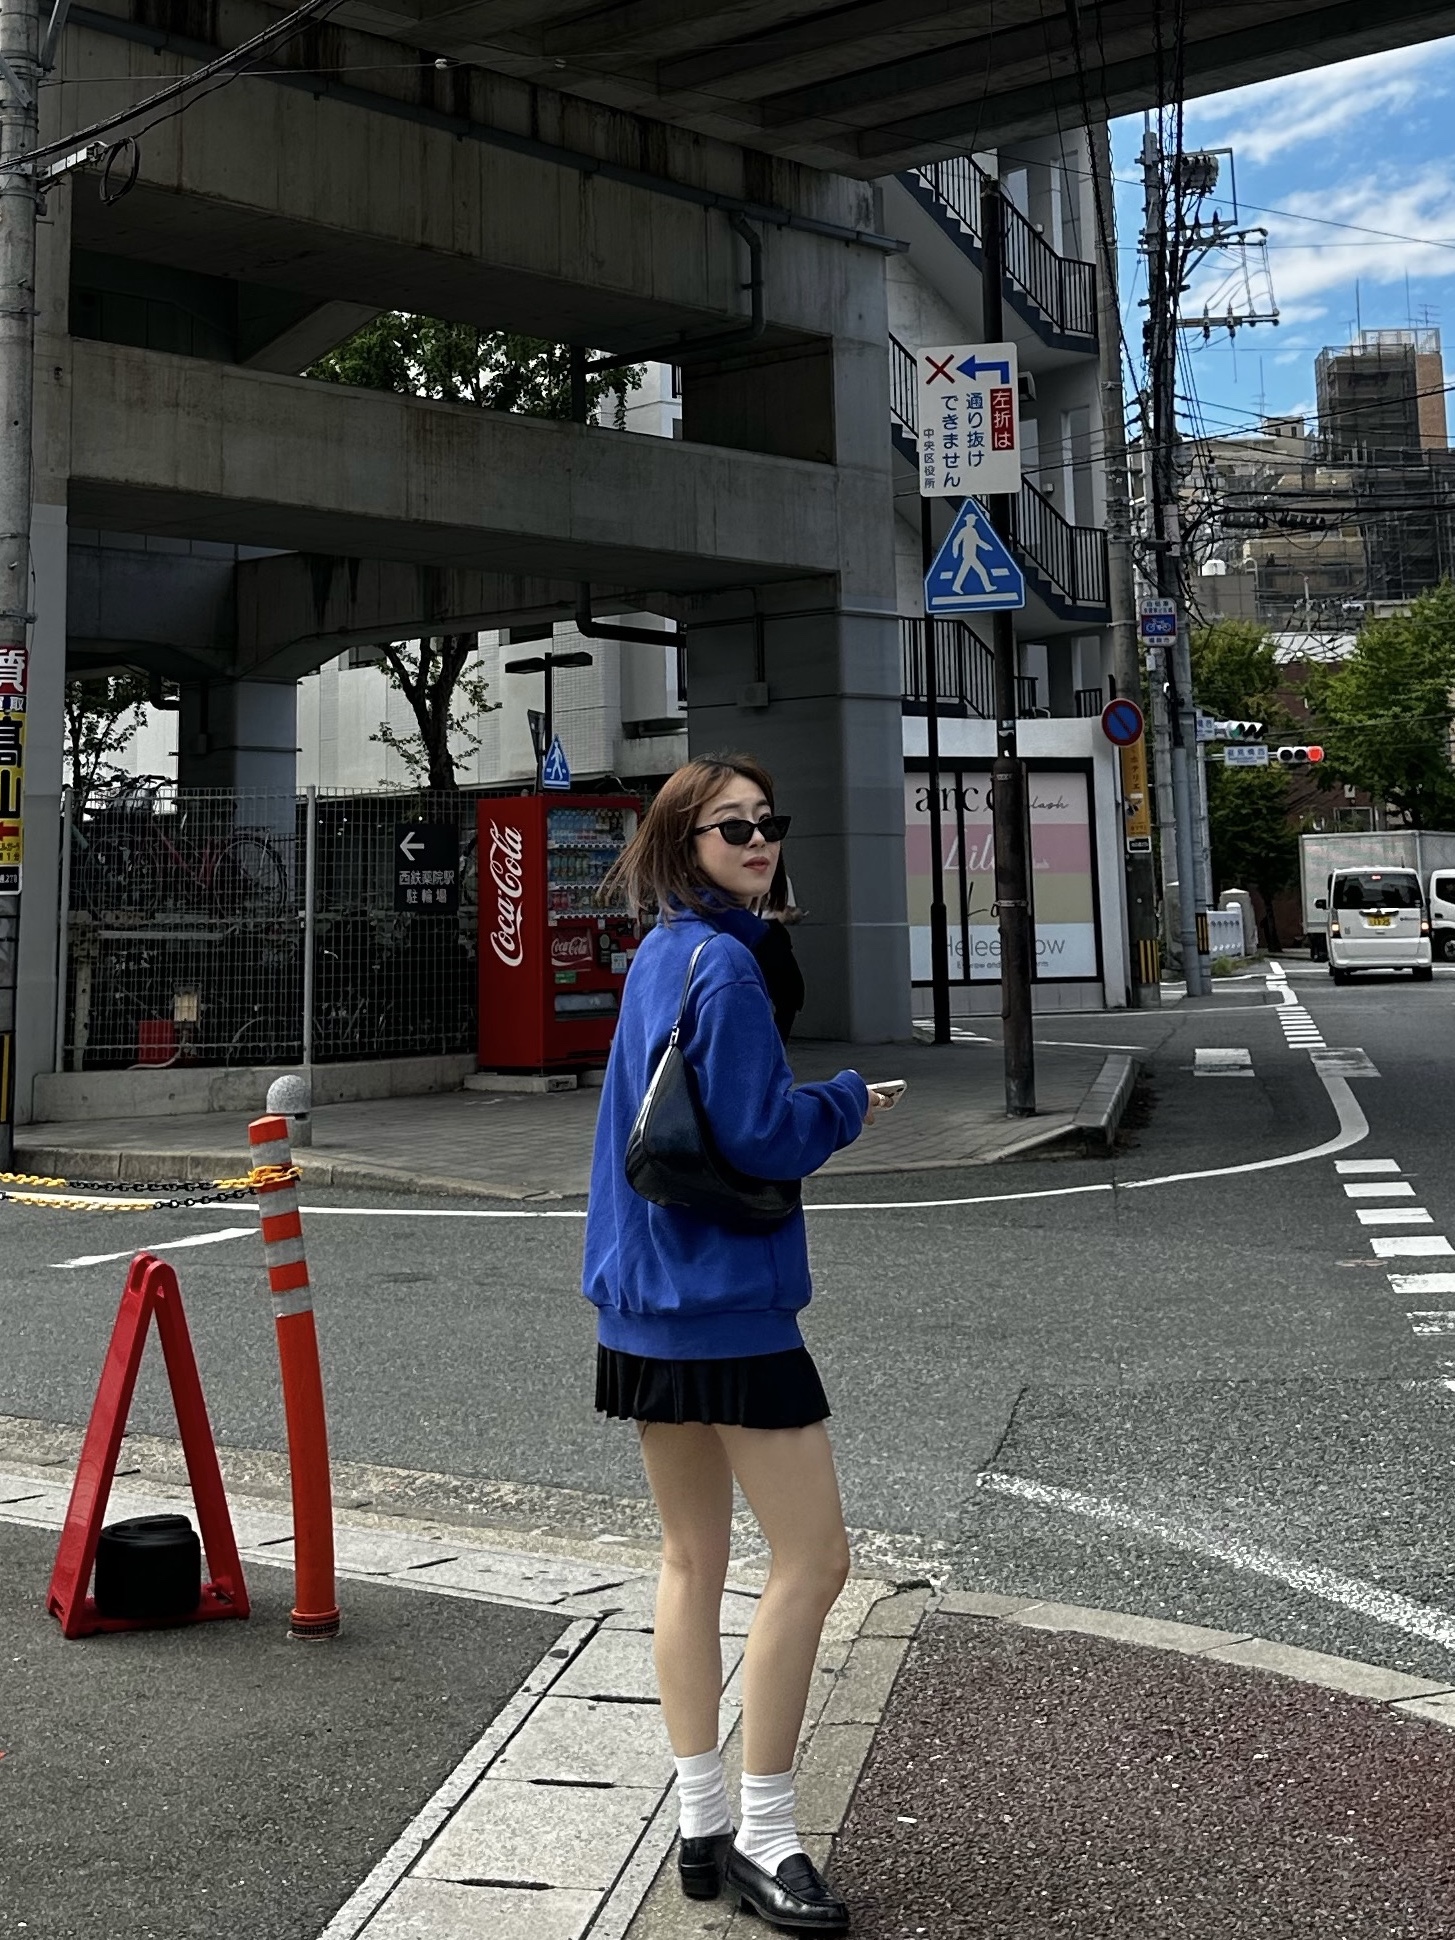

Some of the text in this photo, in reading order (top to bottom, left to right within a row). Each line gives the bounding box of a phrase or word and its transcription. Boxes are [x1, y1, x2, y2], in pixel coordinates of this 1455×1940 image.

[941, 395, 961, 488] できません
[966, 392, 985, 468] 通り抜け
[991, 391, 1013, 449] 左折は
[923, 428, 936, 489] 中央区役所
[0, 697, 24, 711] 取
[399, 870, 455, 885] 西鉄薬院駅
[406, 888, 447, 904] 駐輪場
[490, 818, 523, 967] Coca-Cola
